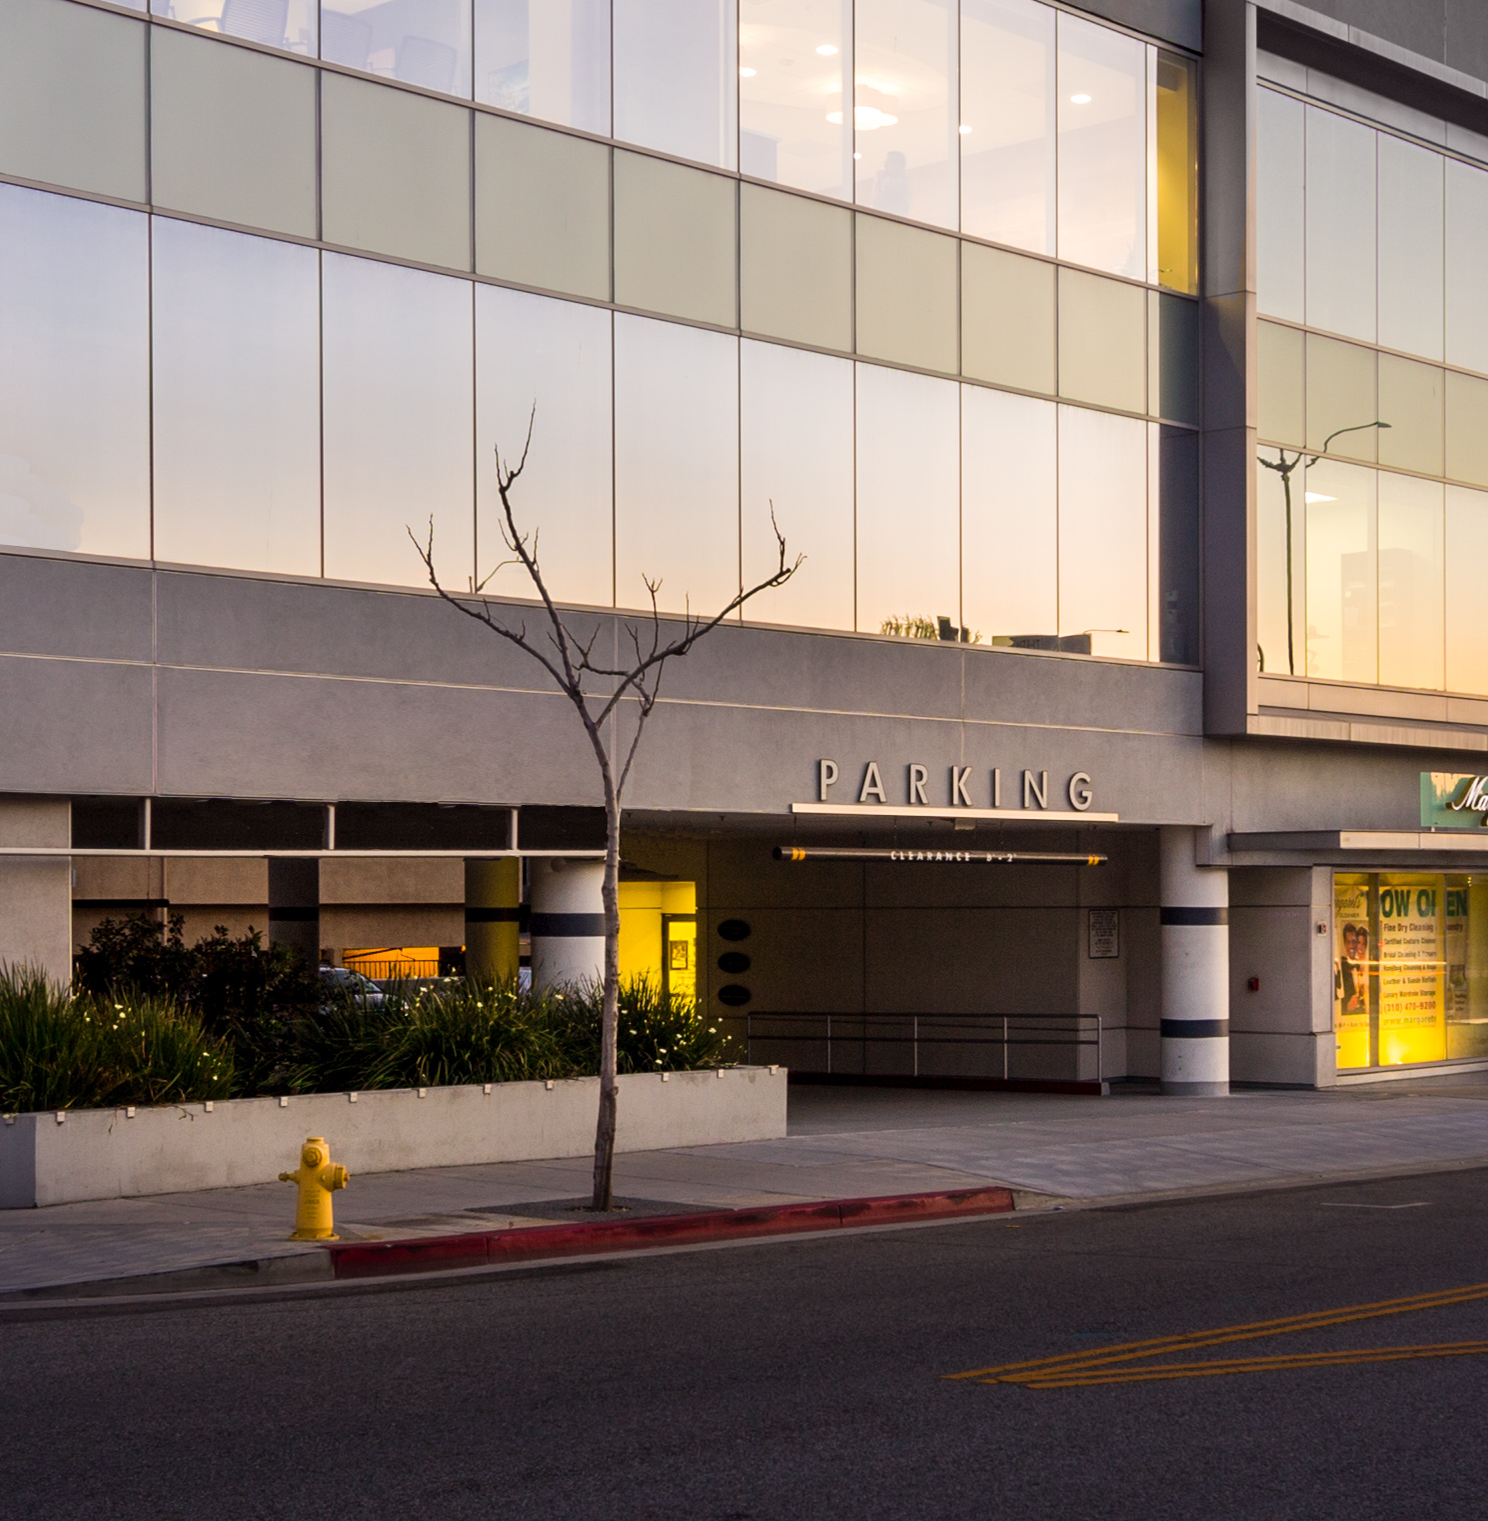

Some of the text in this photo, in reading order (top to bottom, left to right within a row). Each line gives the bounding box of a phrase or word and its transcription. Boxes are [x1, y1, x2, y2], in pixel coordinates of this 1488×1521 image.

[819, 758, 1093, 812] PARKING
[890, 850, 971, 862] CLEARANCE
[1383, 923, 1396, 932] Fine
[1398, 922, 1408, 933] Dry
[1409, 922, 1434, 933] Cleaning
[1383, 1004, 1403, 1013] (310)
